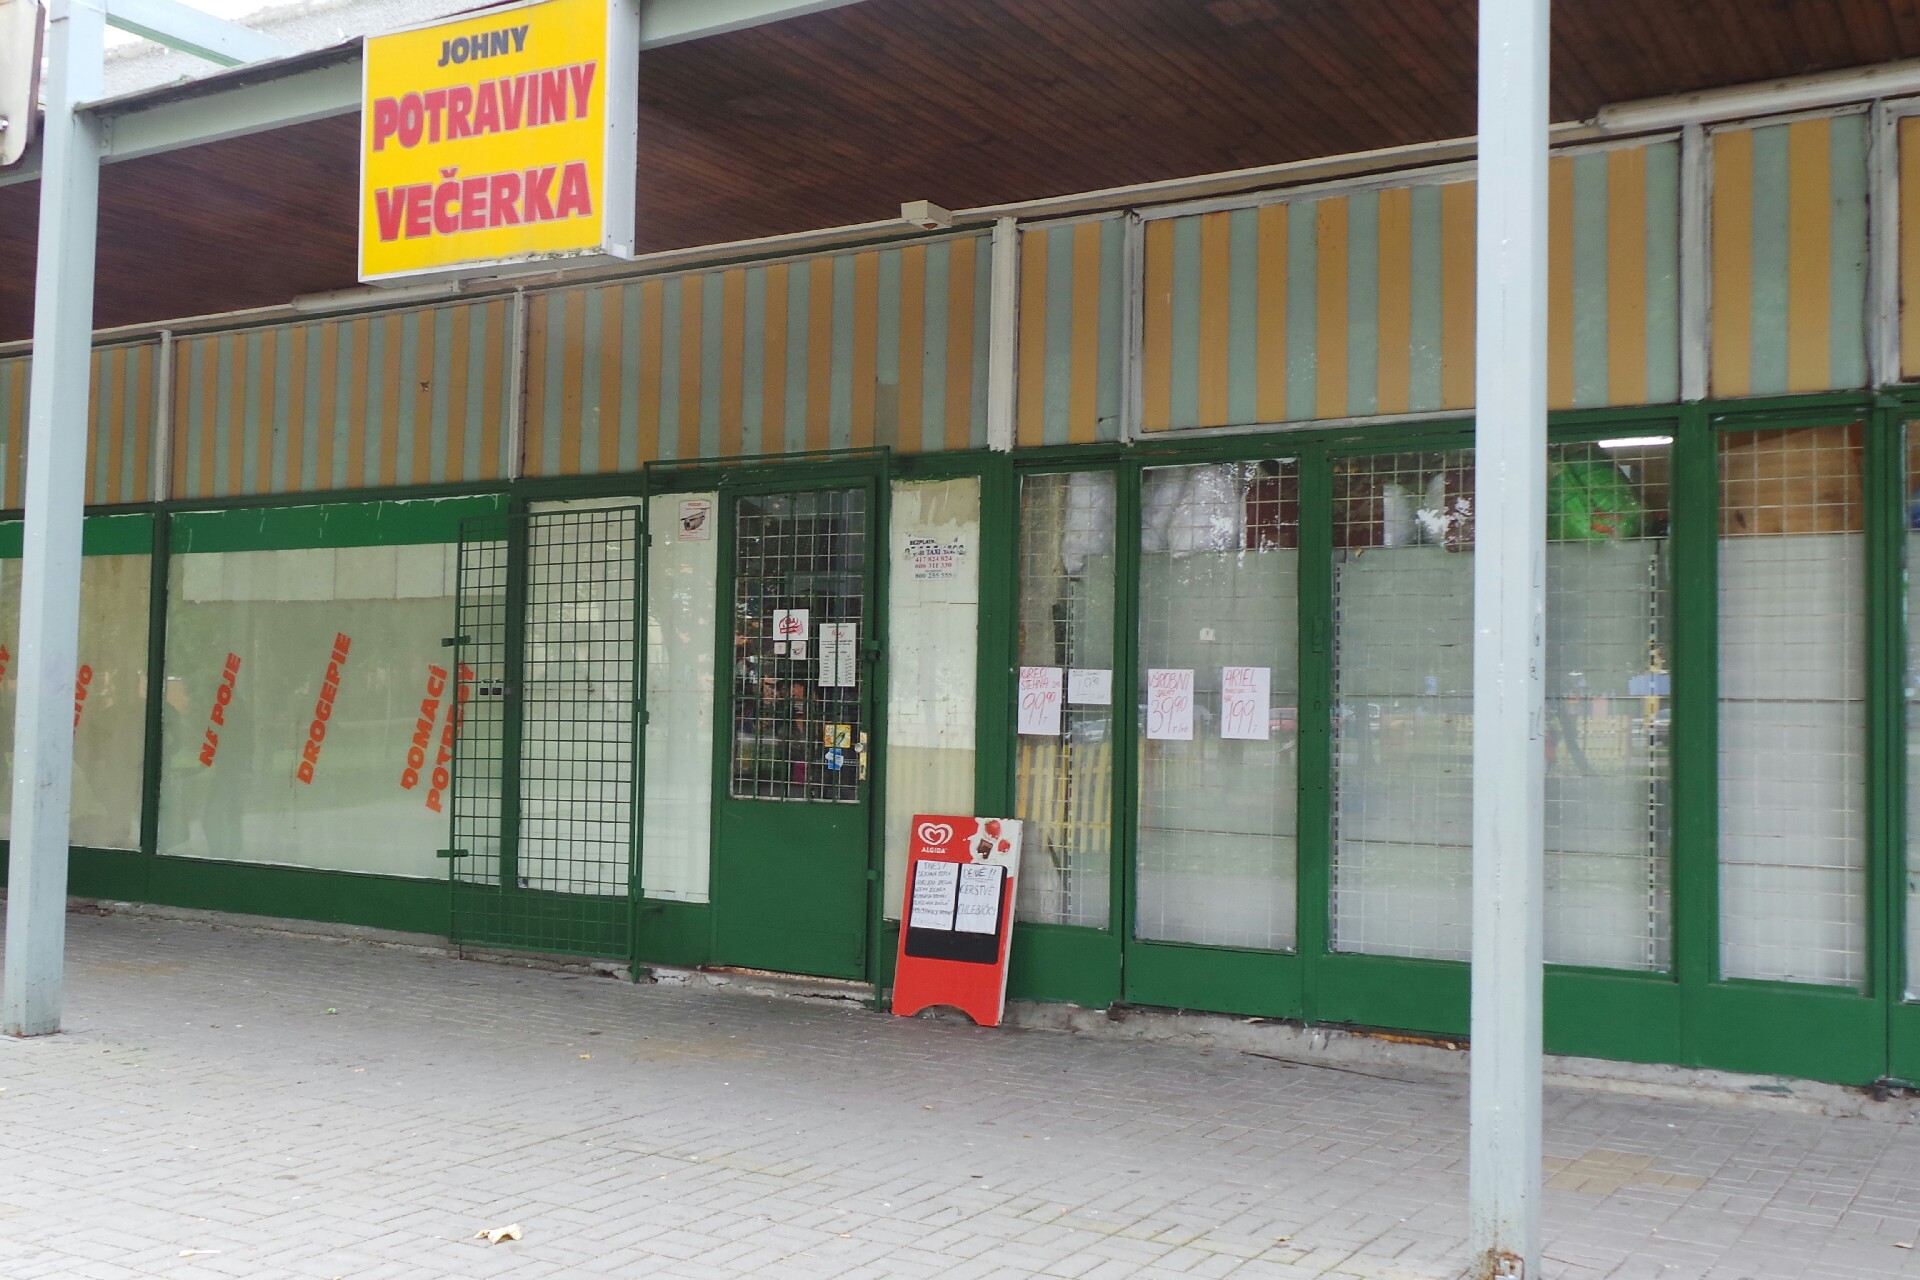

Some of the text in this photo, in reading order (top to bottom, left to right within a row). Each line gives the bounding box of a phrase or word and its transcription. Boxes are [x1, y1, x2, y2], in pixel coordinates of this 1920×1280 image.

[437, 24, 529, 67] JOHNY
[372, 60, 598, 153] POTRAVINY
[374, 160, 593, 243] VEČERKA
[1224, 668, 1257, 687] ARIEL
[921, 846, 946, 854] ALGIDA
